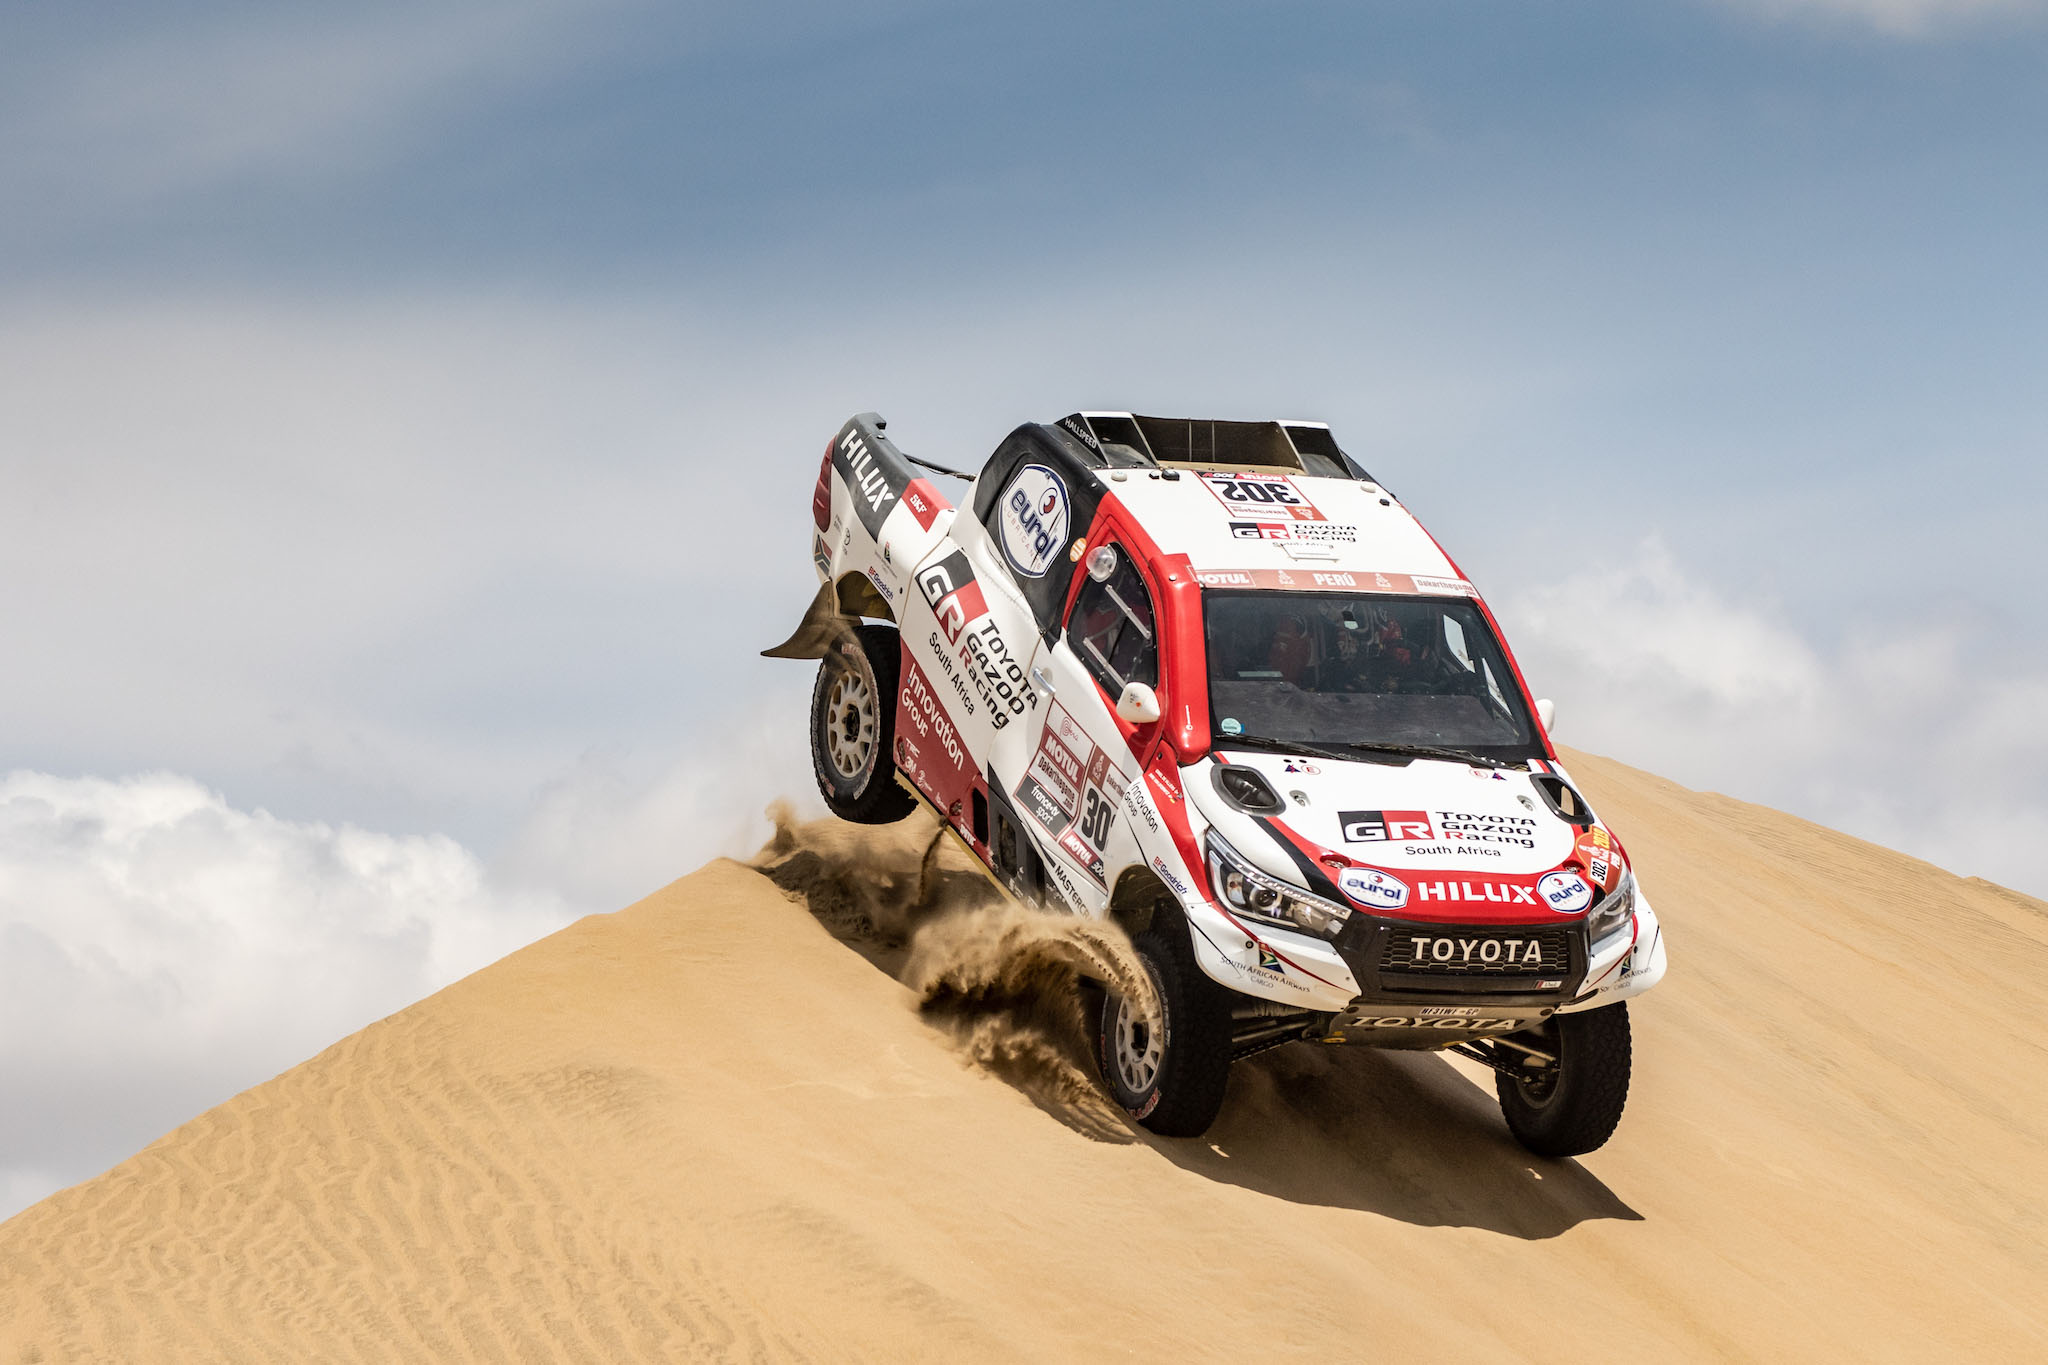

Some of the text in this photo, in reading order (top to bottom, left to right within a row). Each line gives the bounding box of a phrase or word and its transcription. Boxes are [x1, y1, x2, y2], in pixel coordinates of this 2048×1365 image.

[1064, 417, 1098, 449] HALLSPEED
[840, 428, 895, 512] HILUX
[909, 494, 928, 513] SKF
[1211, 480, 1300, 504] 302
[1010, 488, 1059, 562] eurol
[1312, 572, 1357, 587] PERÚ
[919, 565, 966, 637] GR
[929, 631, 975, 716] South Africa
[966, 633, 1025, 715] GAZOO
[981, 619, 1039, 711] TOYOTA
[959, 645, 1010, 730] Racing
[902, 687, 929, 738] Group
[1045, 734, 1080, 784] MOTUL
[1035, 805, 1054, 825] sport
[1123, 791, 1138, 817] Group
[1081, 787, 1117, 851] 30
[1436, 811, 1537, 826] TOYOTA
[1441, 821, 1532, 836] GAZOO
[1064, 837, 1094, 865] MOTUL
[1405, 845, 1501, 857] South Africa
[1445, 831, 1535, 849] Racing
[1153, 856, 1188, 895] BFGoodrich
[1592, 861, 1607, 881] 302
[1346, 877, 1402, 901] eurol
[1418, 881, 1537, 905] HILUX
[1548, 879, 1586, 903] eurol
[1411, 937, 1542, 962] TOYOTA
[1220, 956, 1310, 993] SOUTH AFRICAN AIRWAYS
[1251, 976, 1274, 988] CARGO
[1351, 1016, 1517, 1030] TOYOTA
